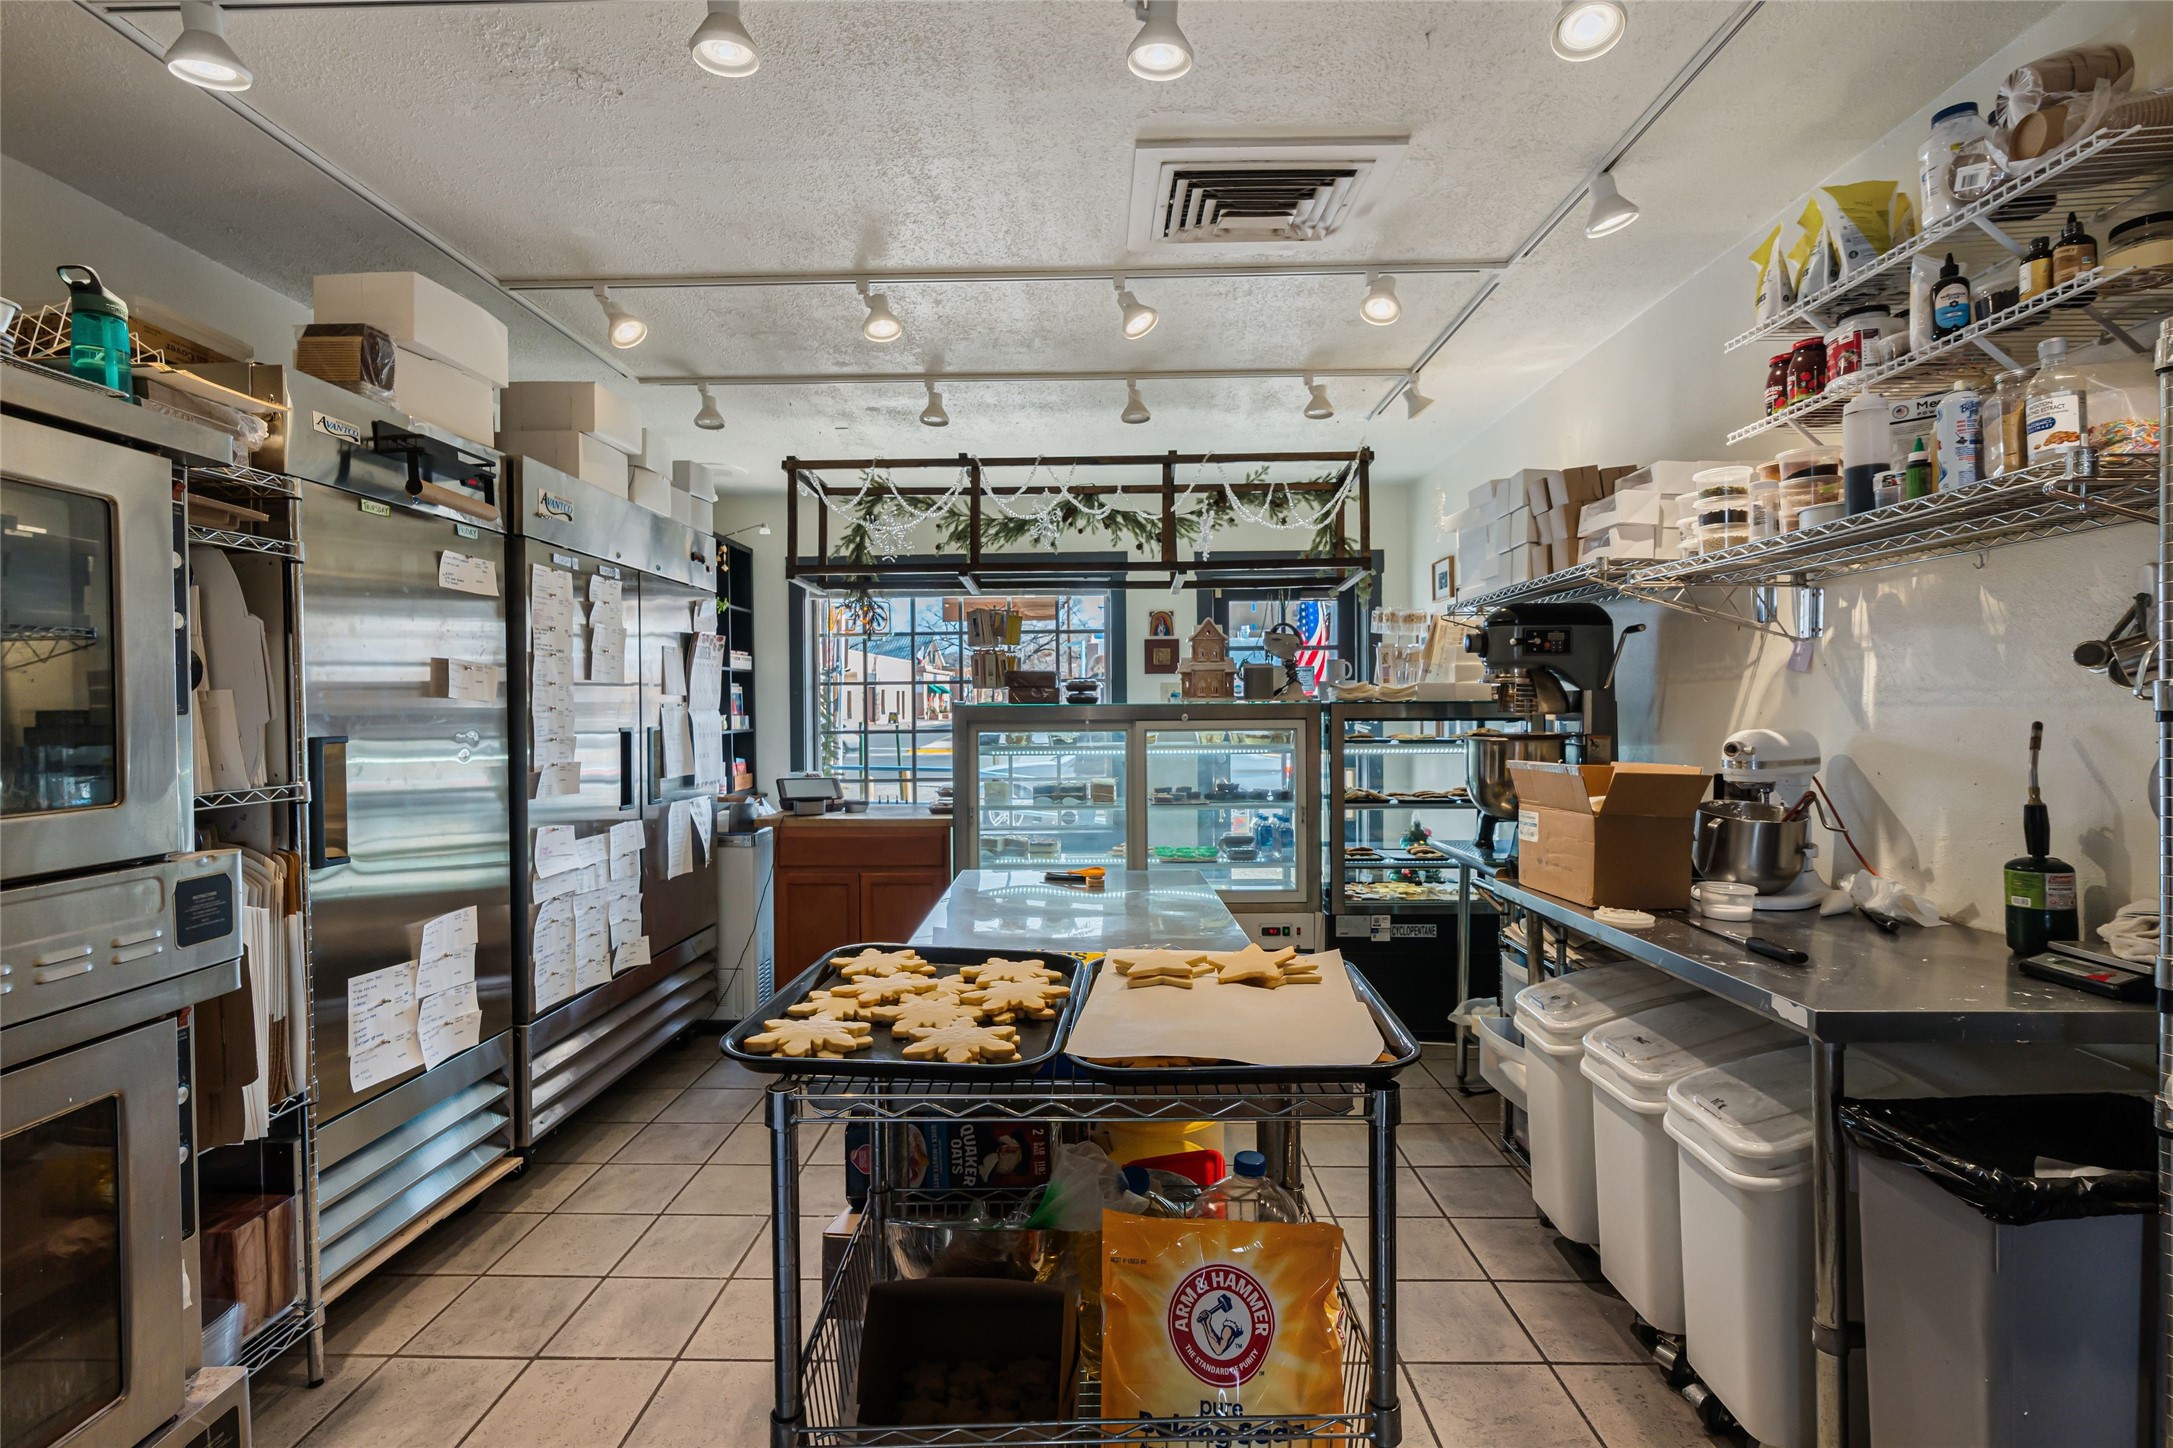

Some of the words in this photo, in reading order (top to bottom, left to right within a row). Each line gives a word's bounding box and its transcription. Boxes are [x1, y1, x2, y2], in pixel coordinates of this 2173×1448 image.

[165, 342, 195, 362] Cover
[316, 416, 359, 441] AVANTCO
[540, 492, 573, 521] AVANTCO
[1391, 925, 1436, 936] CYCLOPENTANE
[951, 1138, 963, 1174] OATS
[960, 1124, 977, 1186] QUAKER
[1175, 1286, 1198, 1332] ARM
[1194, 1276, 1210, 1294] &
[1210, 1271, 1269, 1336] HAMMER
[1185, 1343, 1195, 1359] THE
[1194, 1356, 1229, 1375] STANDARD
[1229, 1365, 1240, 1374] OF
[1239, 1348, 1259, 1371] PURITY
[1200, 1400, 1244, 1417] pure
